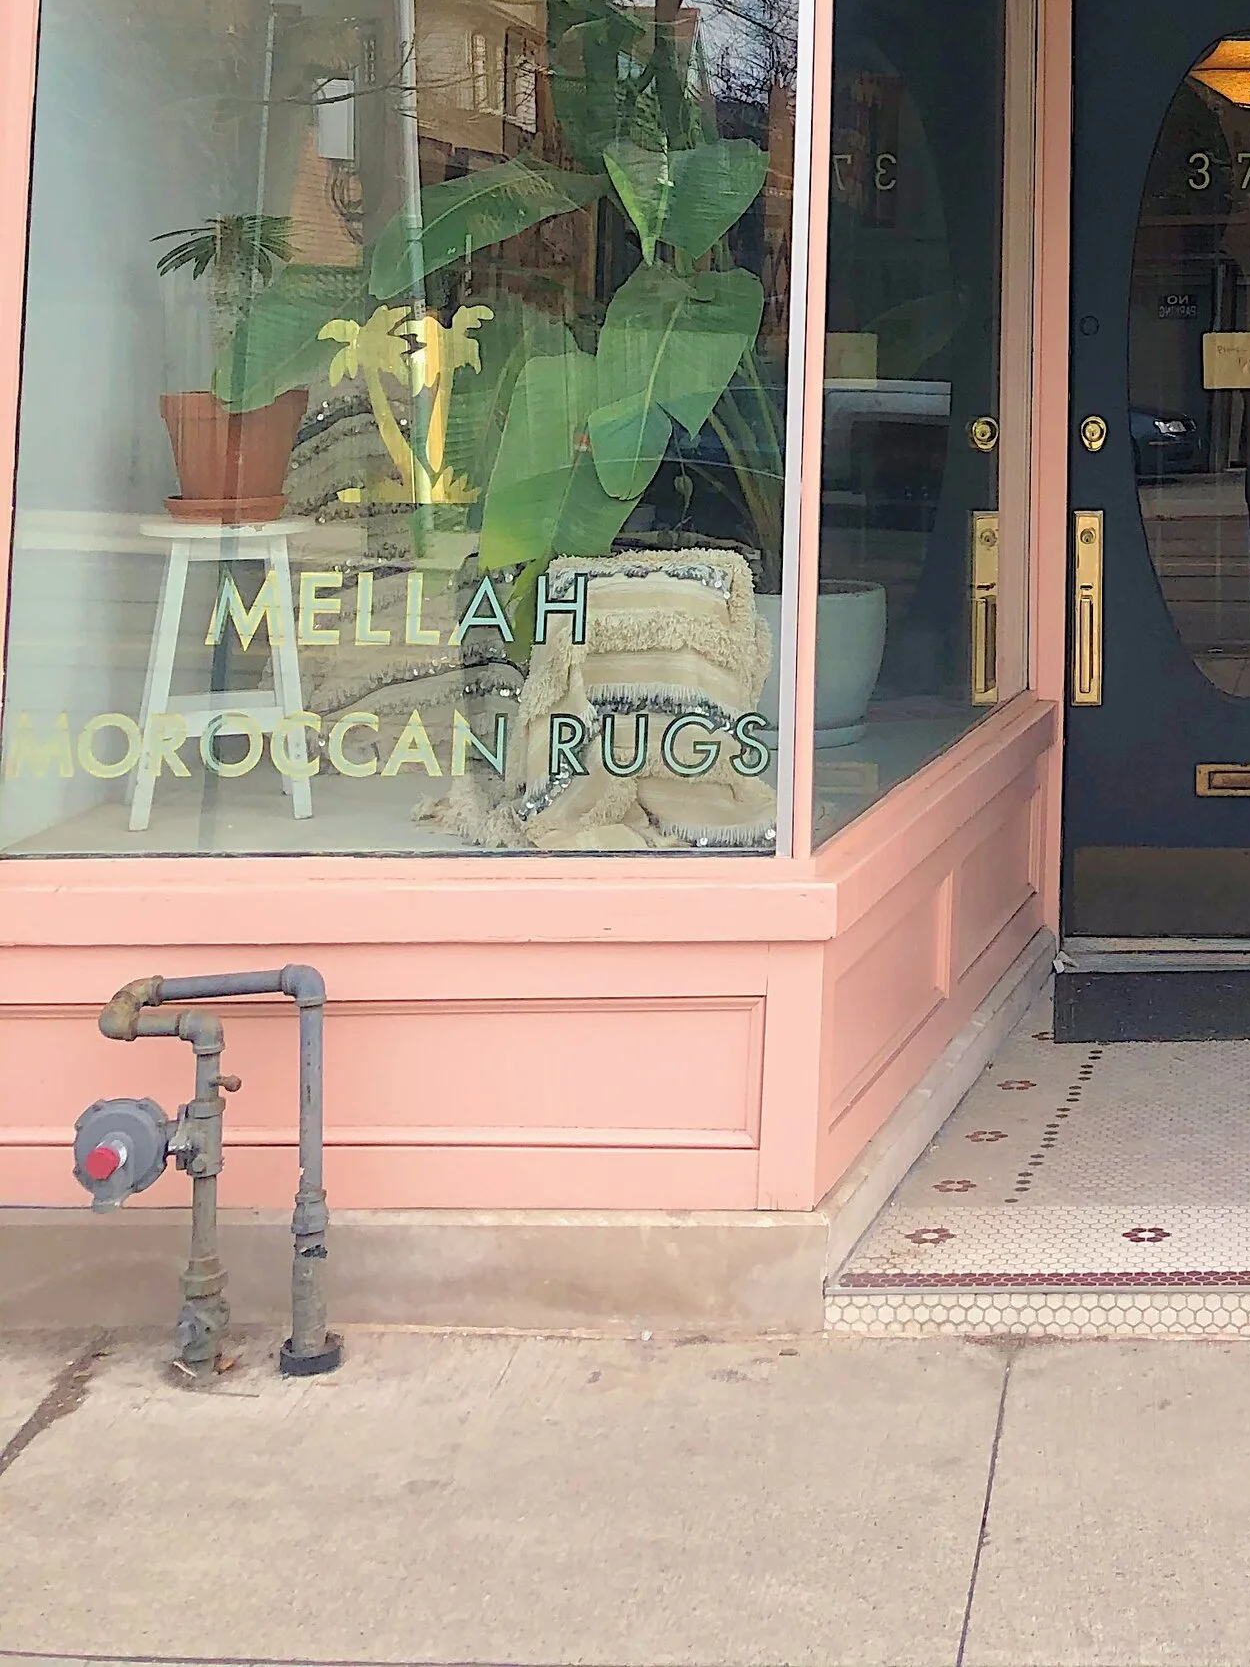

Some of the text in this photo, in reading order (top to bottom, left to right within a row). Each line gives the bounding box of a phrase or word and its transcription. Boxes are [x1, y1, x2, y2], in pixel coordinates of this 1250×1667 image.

[205, 572, 588, 651] MELLAH
[5, 710, 771, 779] MOROCCAN RUGS
